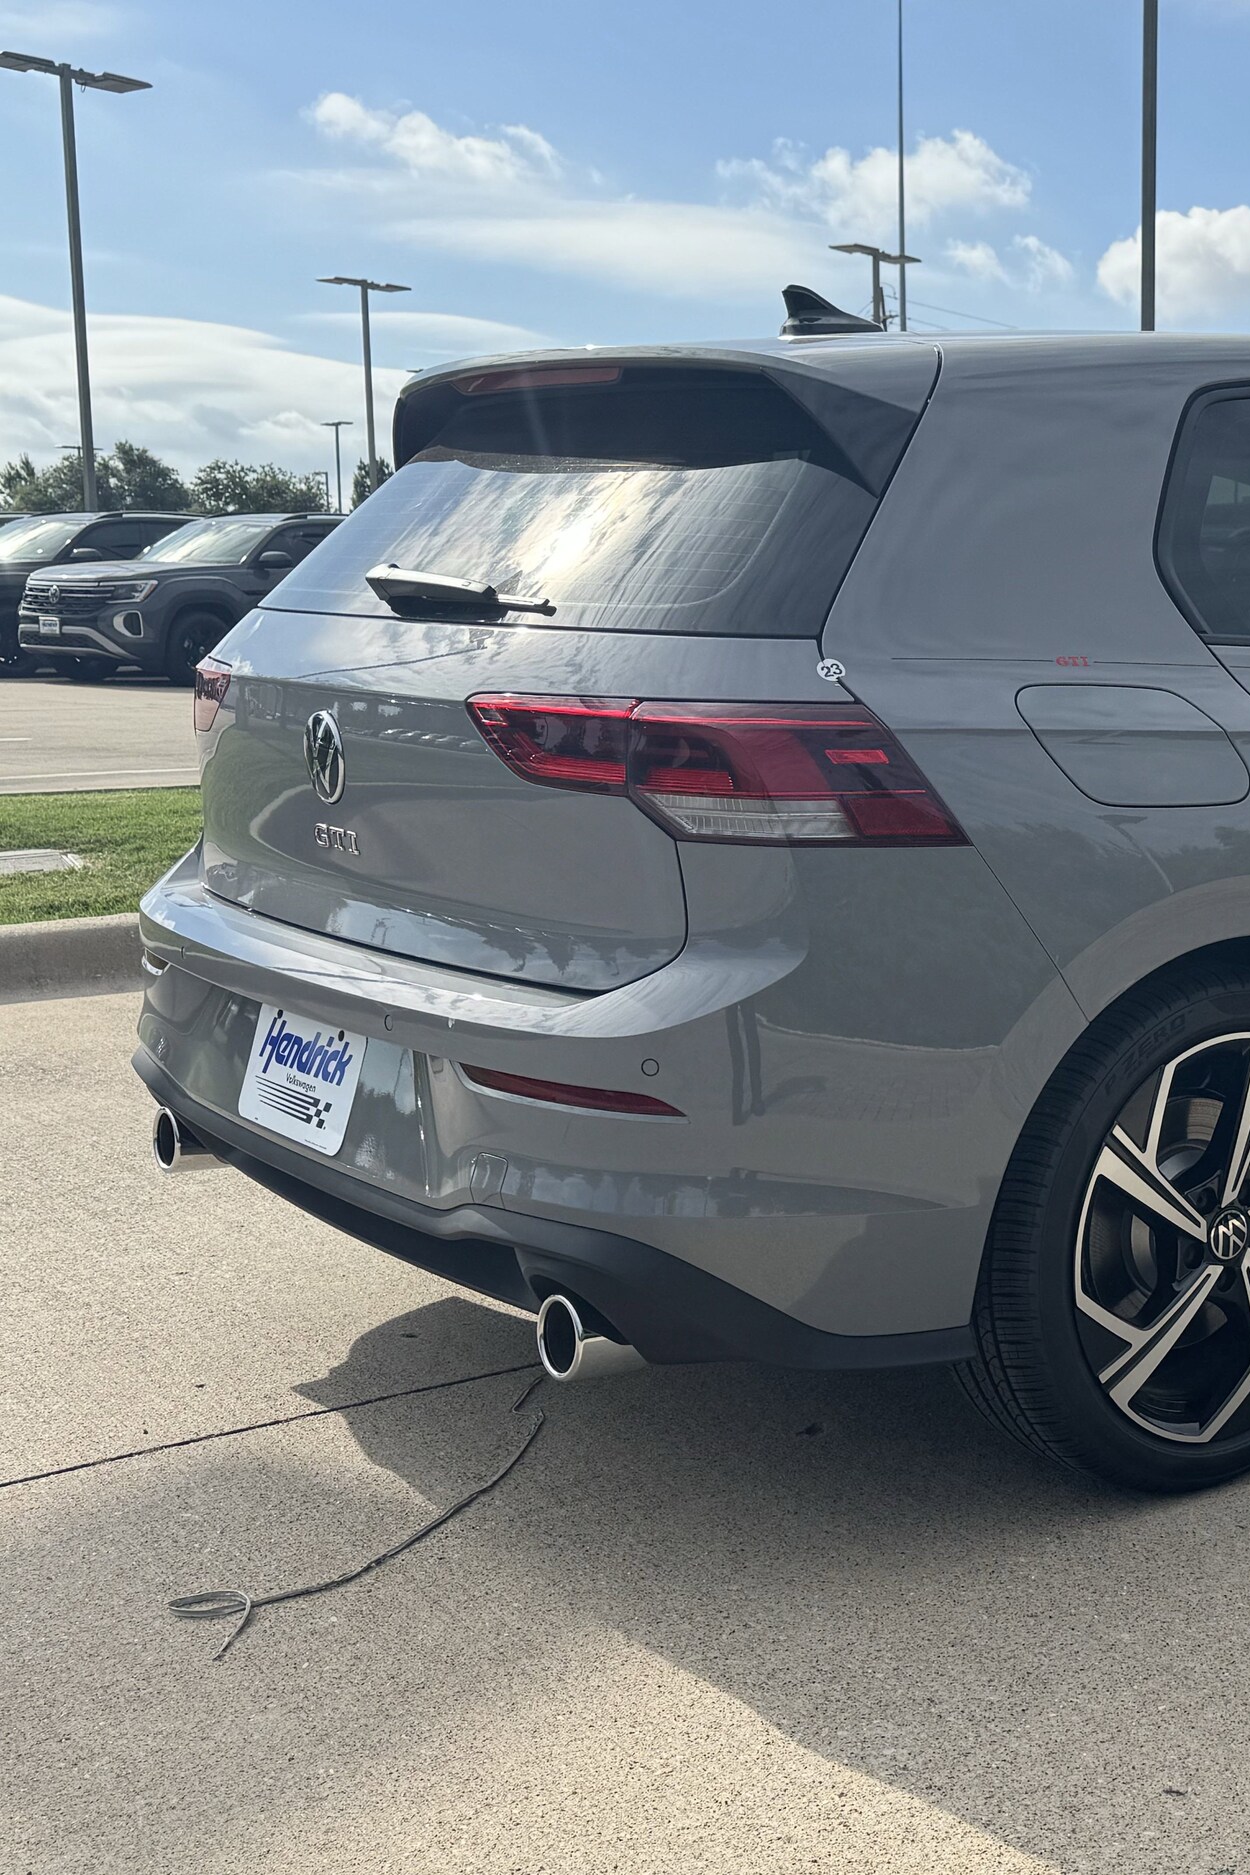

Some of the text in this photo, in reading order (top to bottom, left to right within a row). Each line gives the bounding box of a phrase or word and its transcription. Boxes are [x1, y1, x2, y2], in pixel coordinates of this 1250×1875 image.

[820, 663, 843, 678] 23
[1055, 656, 1091, 667] GTI
[314, 822, 361, 856] GTI
[258, 1016, 353, 1086] Hendrick
[286, 1073, 317, 1093] Volkswagen
